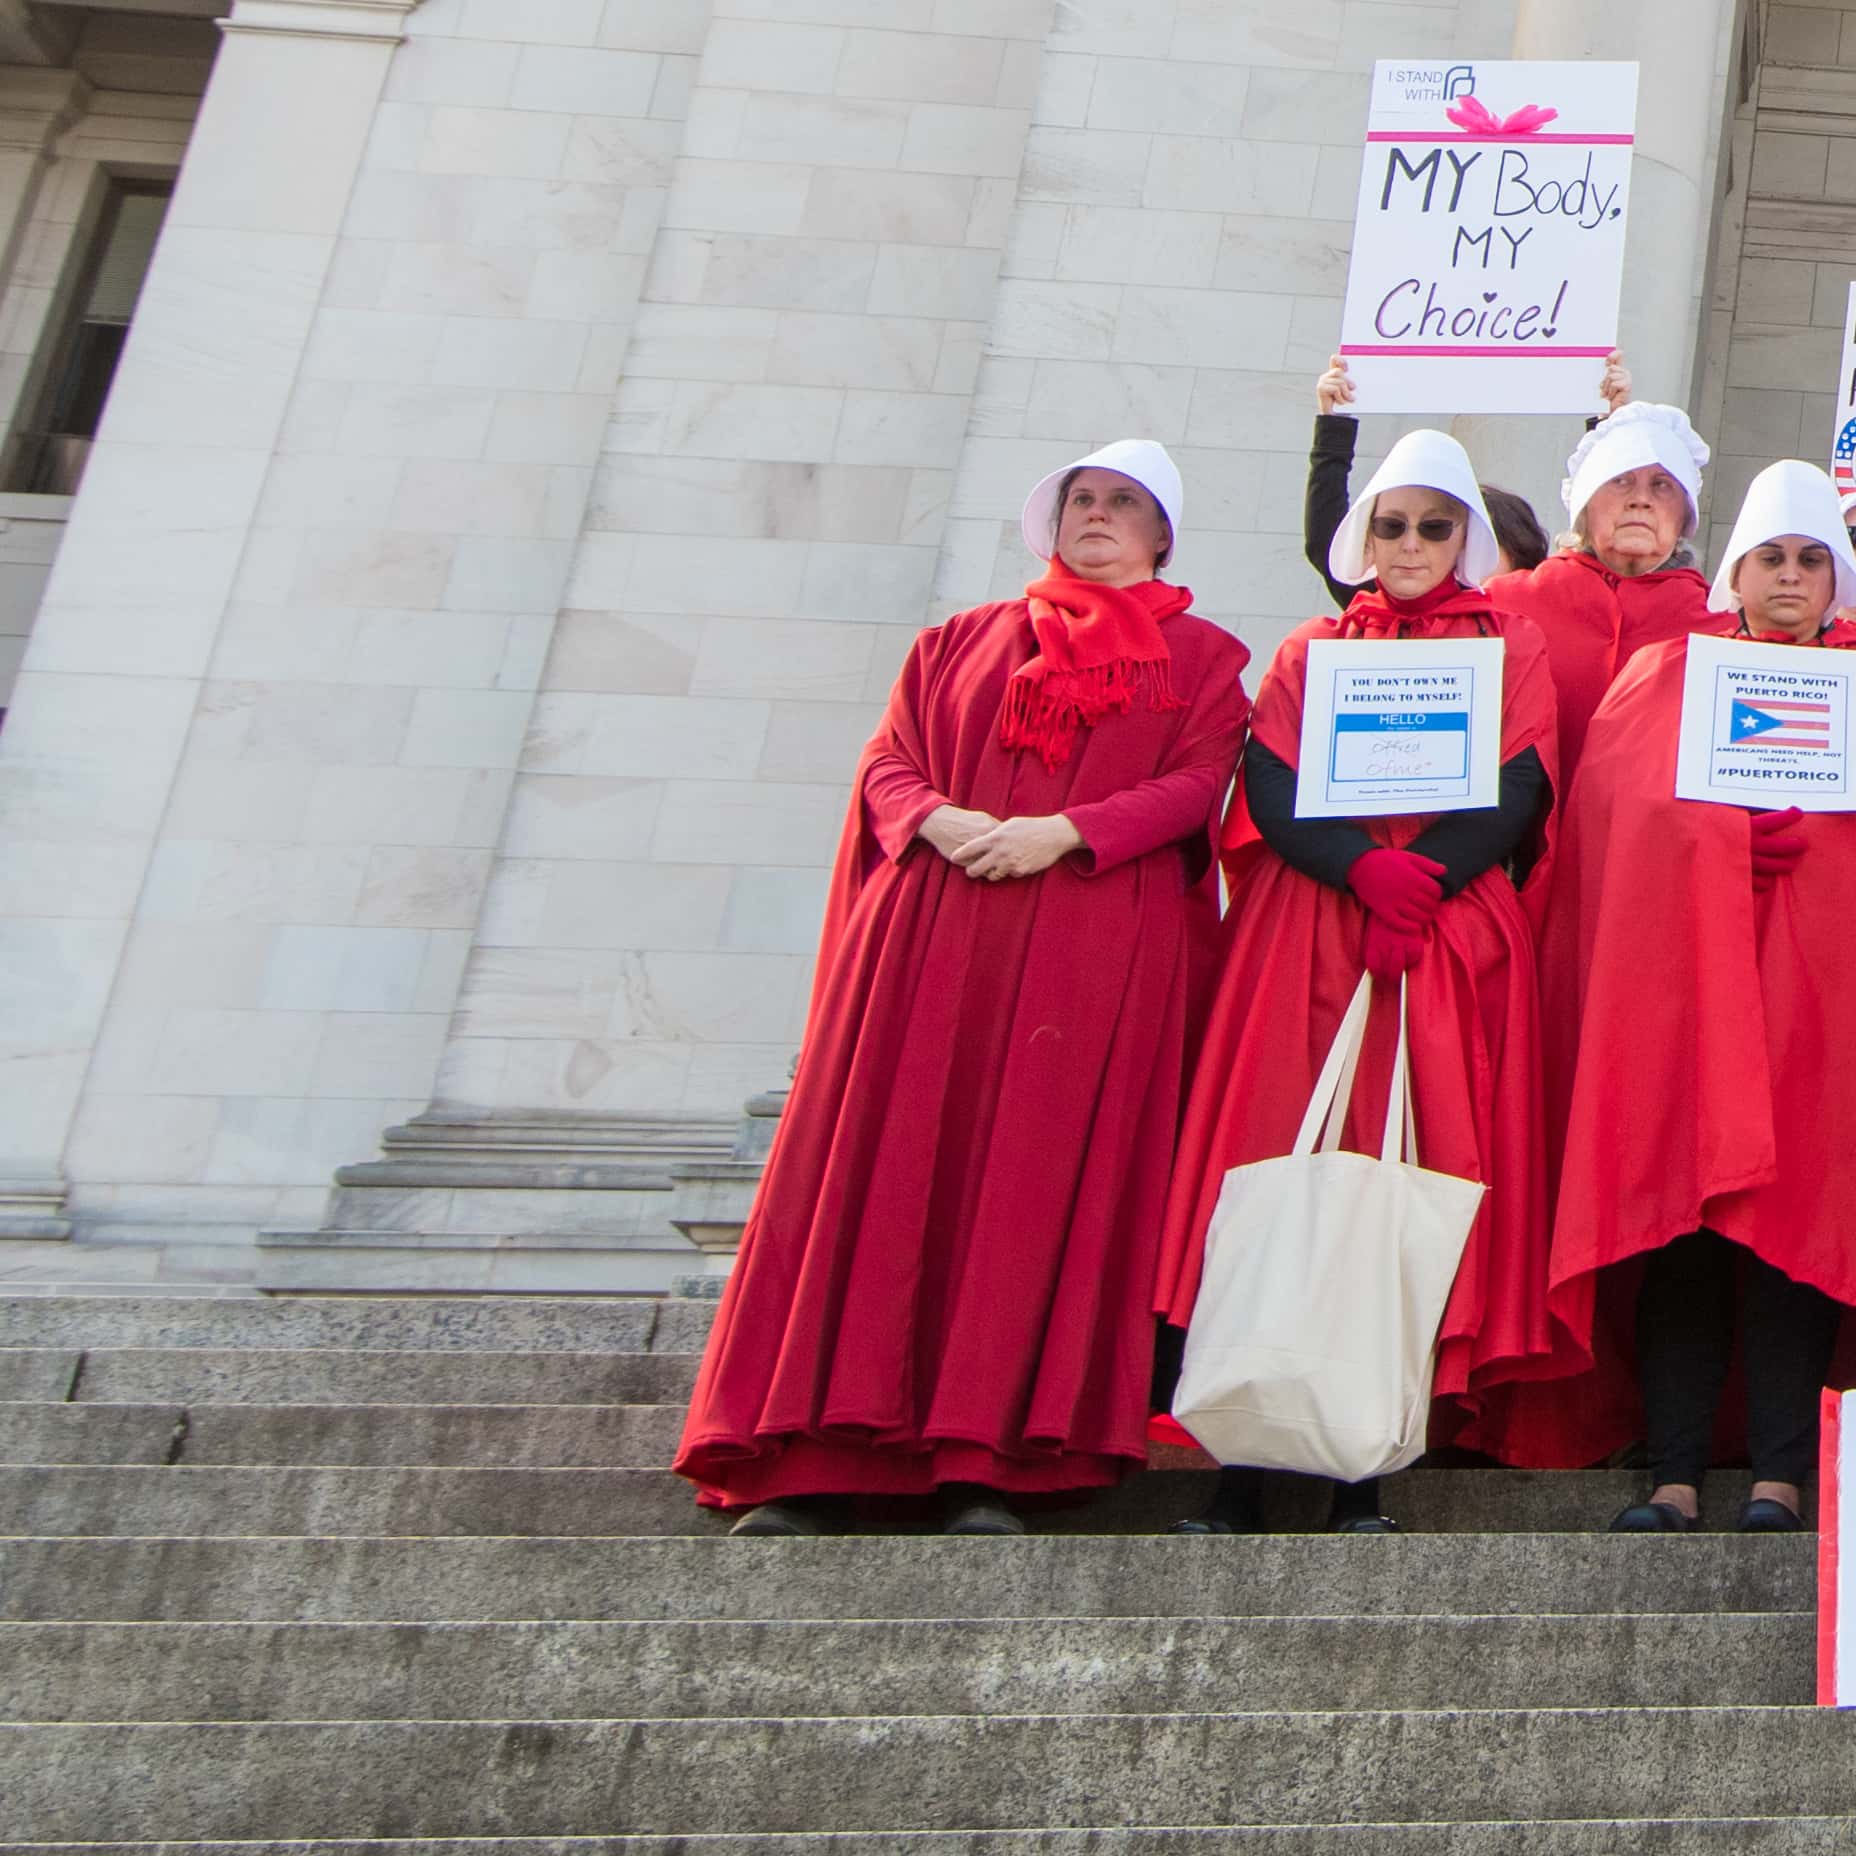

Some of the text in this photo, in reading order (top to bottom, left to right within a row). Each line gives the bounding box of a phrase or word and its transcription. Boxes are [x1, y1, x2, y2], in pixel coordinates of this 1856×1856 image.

[1395, 71, 1444, 83] STAND
[1404, 89, 1442, 101] WITH
[1380, 147, 1622, 229] MY Body,
[1452, 226, 1533, 269] MY
[1375, 279, 1568, 340] Choice!
[1352, 676, 1458, 687] YOU DON'T OWN ME
[1727, 671, 1838, 688] WE STAND WITH
[1352, 693, 1396, 702] BELONG
[1400, 693, 1413, 702] TO
[1736, 686, 1828, 701] PUERTO RICO!
[1378, 713, 1427, 726] HELLO
[1717, 767, 1840, 782] #PUERTORICO
